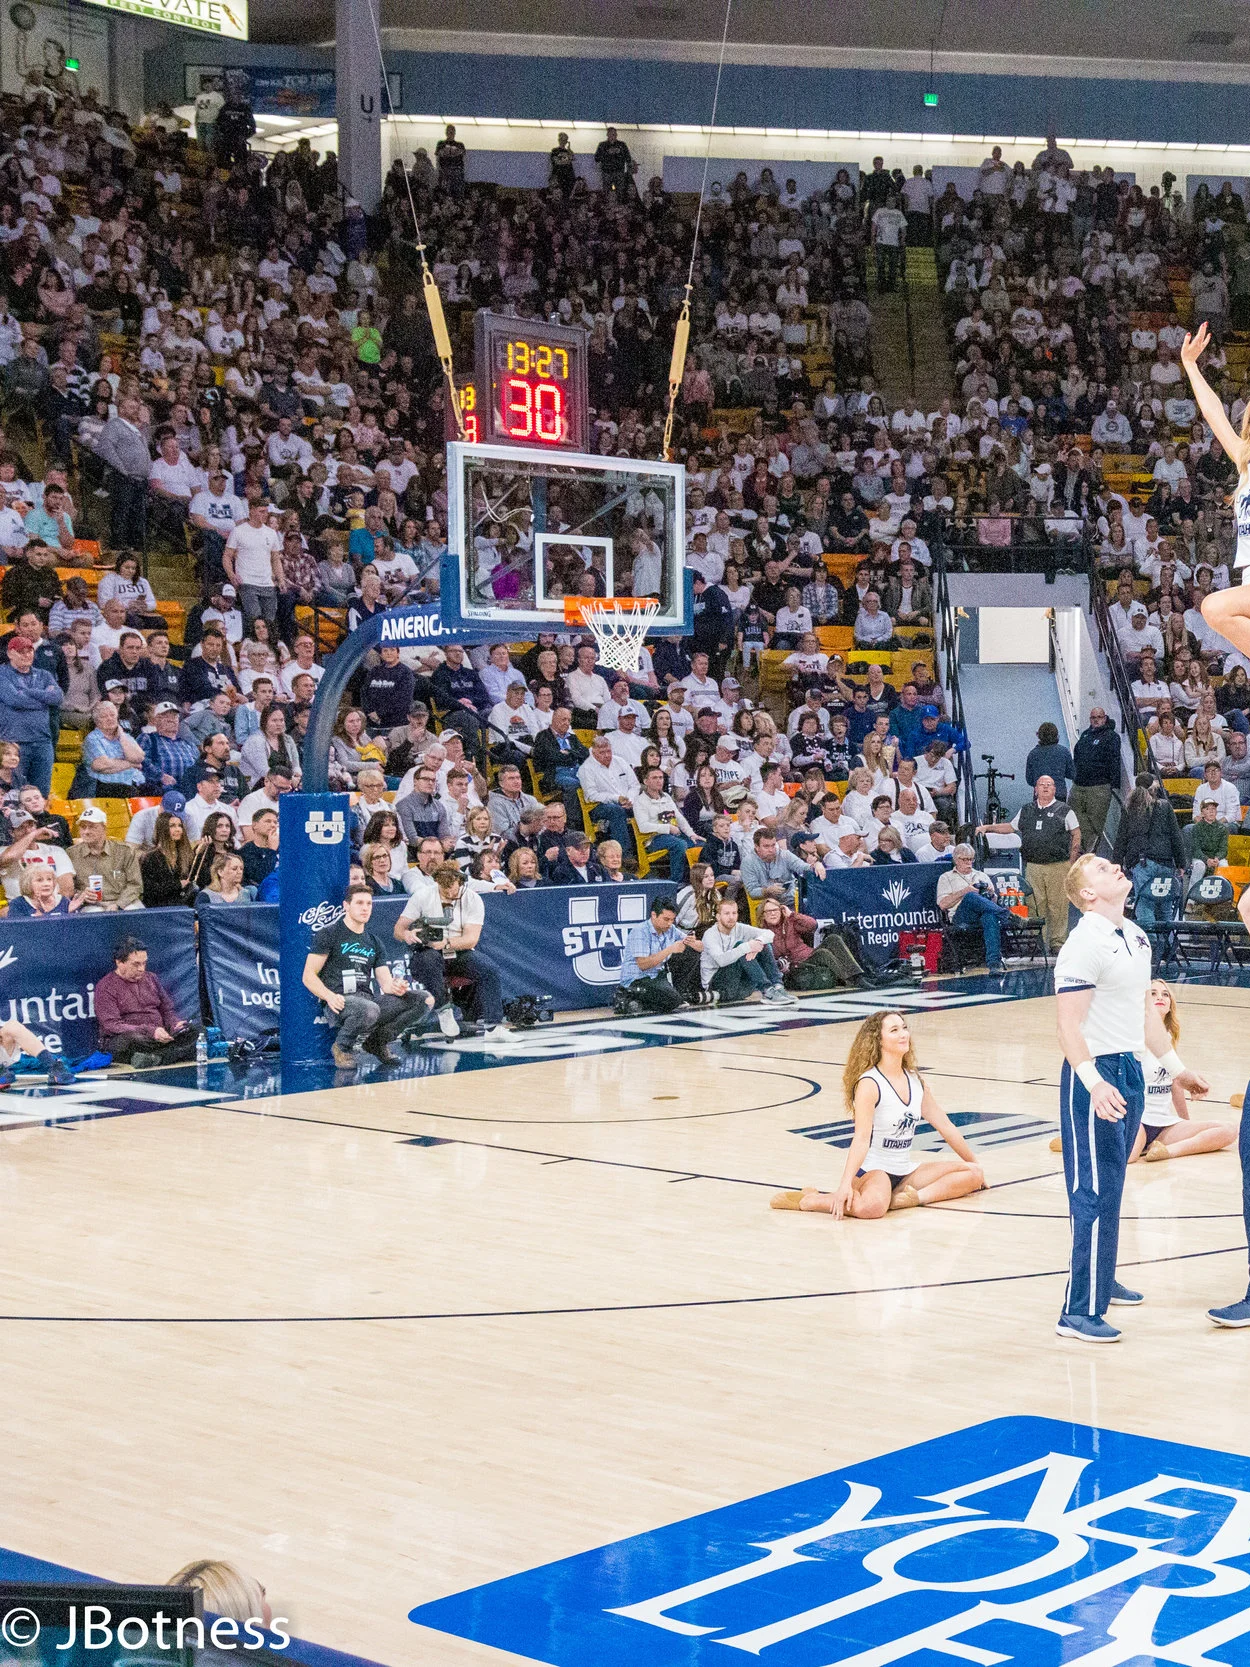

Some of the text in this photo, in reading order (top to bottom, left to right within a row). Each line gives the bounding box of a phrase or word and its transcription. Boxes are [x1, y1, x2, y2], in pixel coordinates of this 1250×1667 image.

[361, 95, 373, 114] U
[507, 342, 569, 379] 13:27
[508, 378, 561, 441] 30
[841, 905, 942, 931] Intermountai
[561, 920, 632, 958] STAT
[242, 988, 280, 1008] Loga
[883, 1137, 902, 1149] UTAH
